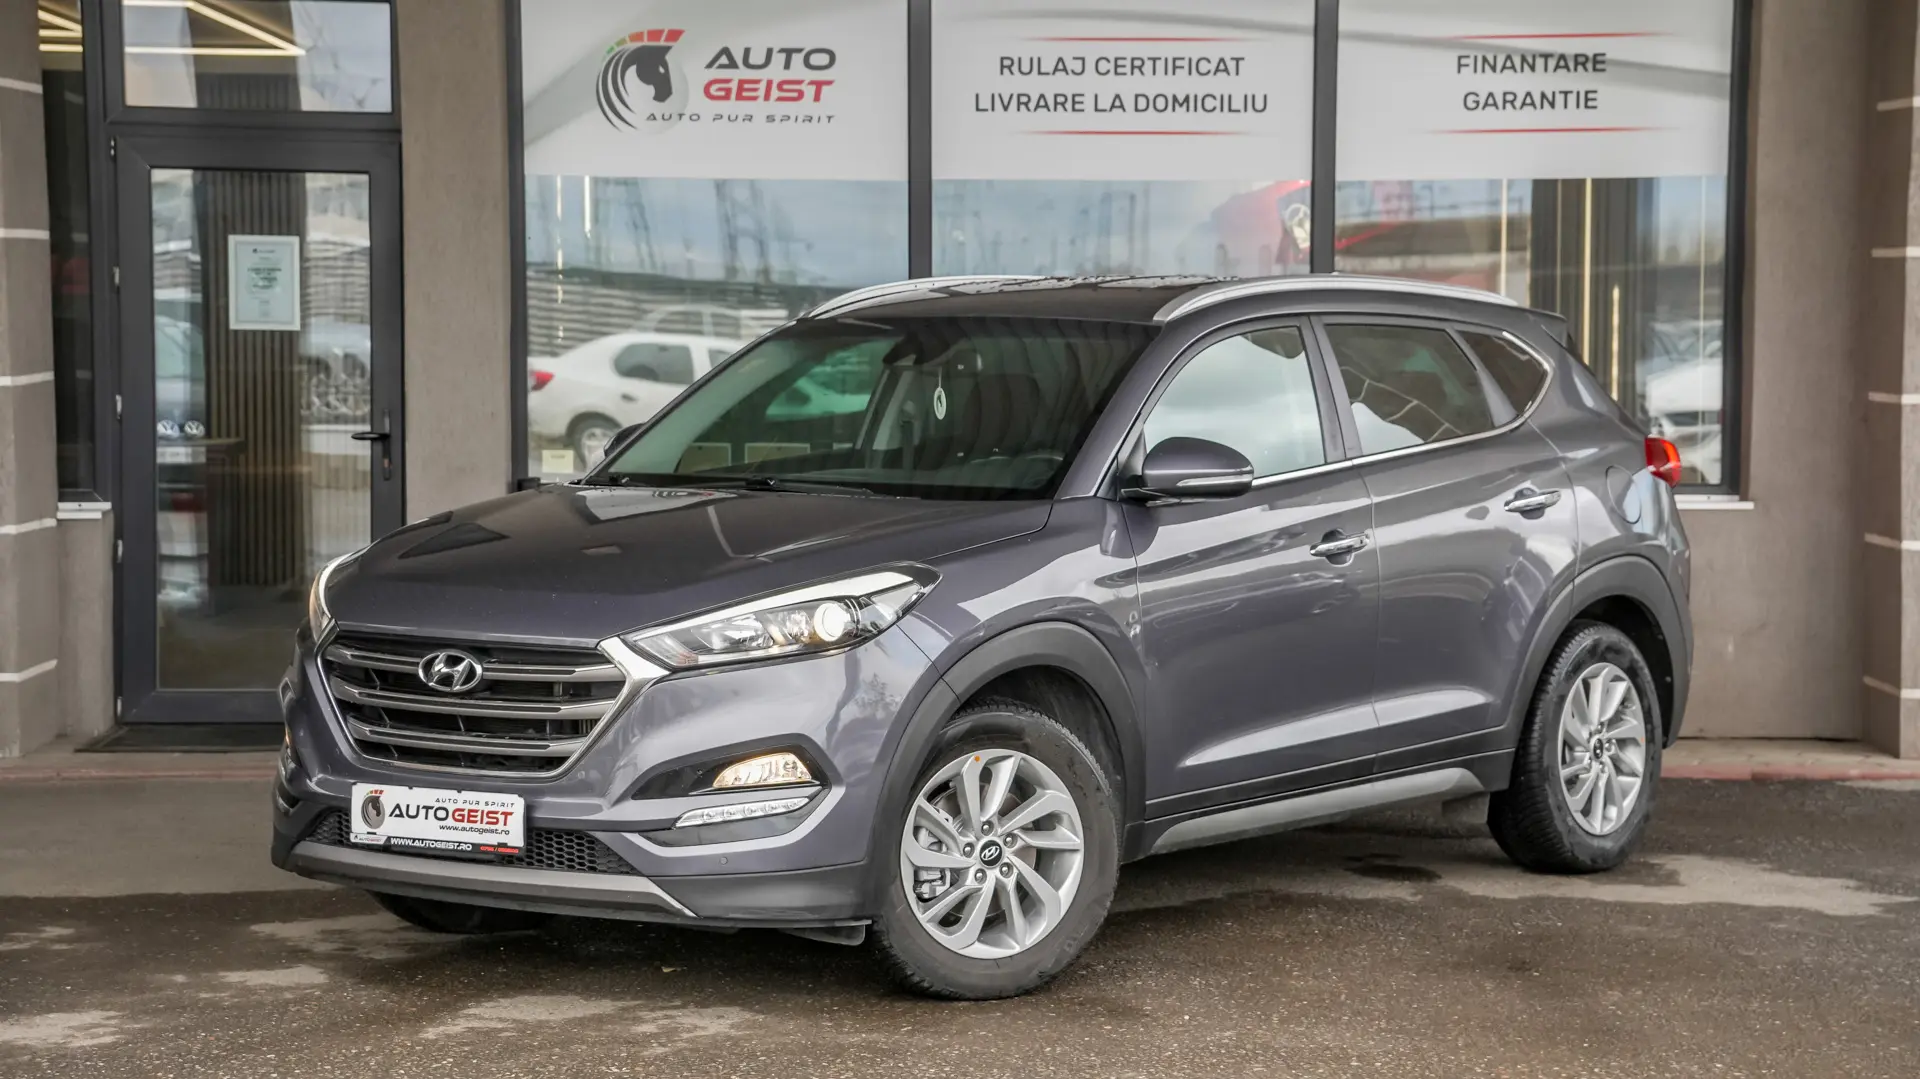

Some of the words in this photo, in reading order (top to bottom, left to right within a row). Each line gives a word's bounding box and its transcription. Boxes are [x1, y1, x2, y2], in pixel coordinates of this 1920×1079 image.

[704, 46, 837, 71] AUTO
[999, 56, 1086, 76] RULAJ
[1094, 56, 1246, 77] CERTIFICAT
[1456, 52, 1608, 75] FINANTARE
[703, 78, 836, 103] GEIST
[974, 93, 1086, 113] LIVRARE
[1093, 93, 1127, 113] LA
[1133, 93, 1268, 113] DOMICILIU
[1462, 90, 1599, 112] GARANTIE
[645, 112, 701, 122] AUTO
[712, 113, 754, 123] PUR
[765, 114, 836, 124] SPIRIT
[484, 800, 515, 808] SPIRIT
[438, 824, 510, 836] www.autogeist.ro
[390, 837, 473, 851] WWW.AUTOGEIST.RO
